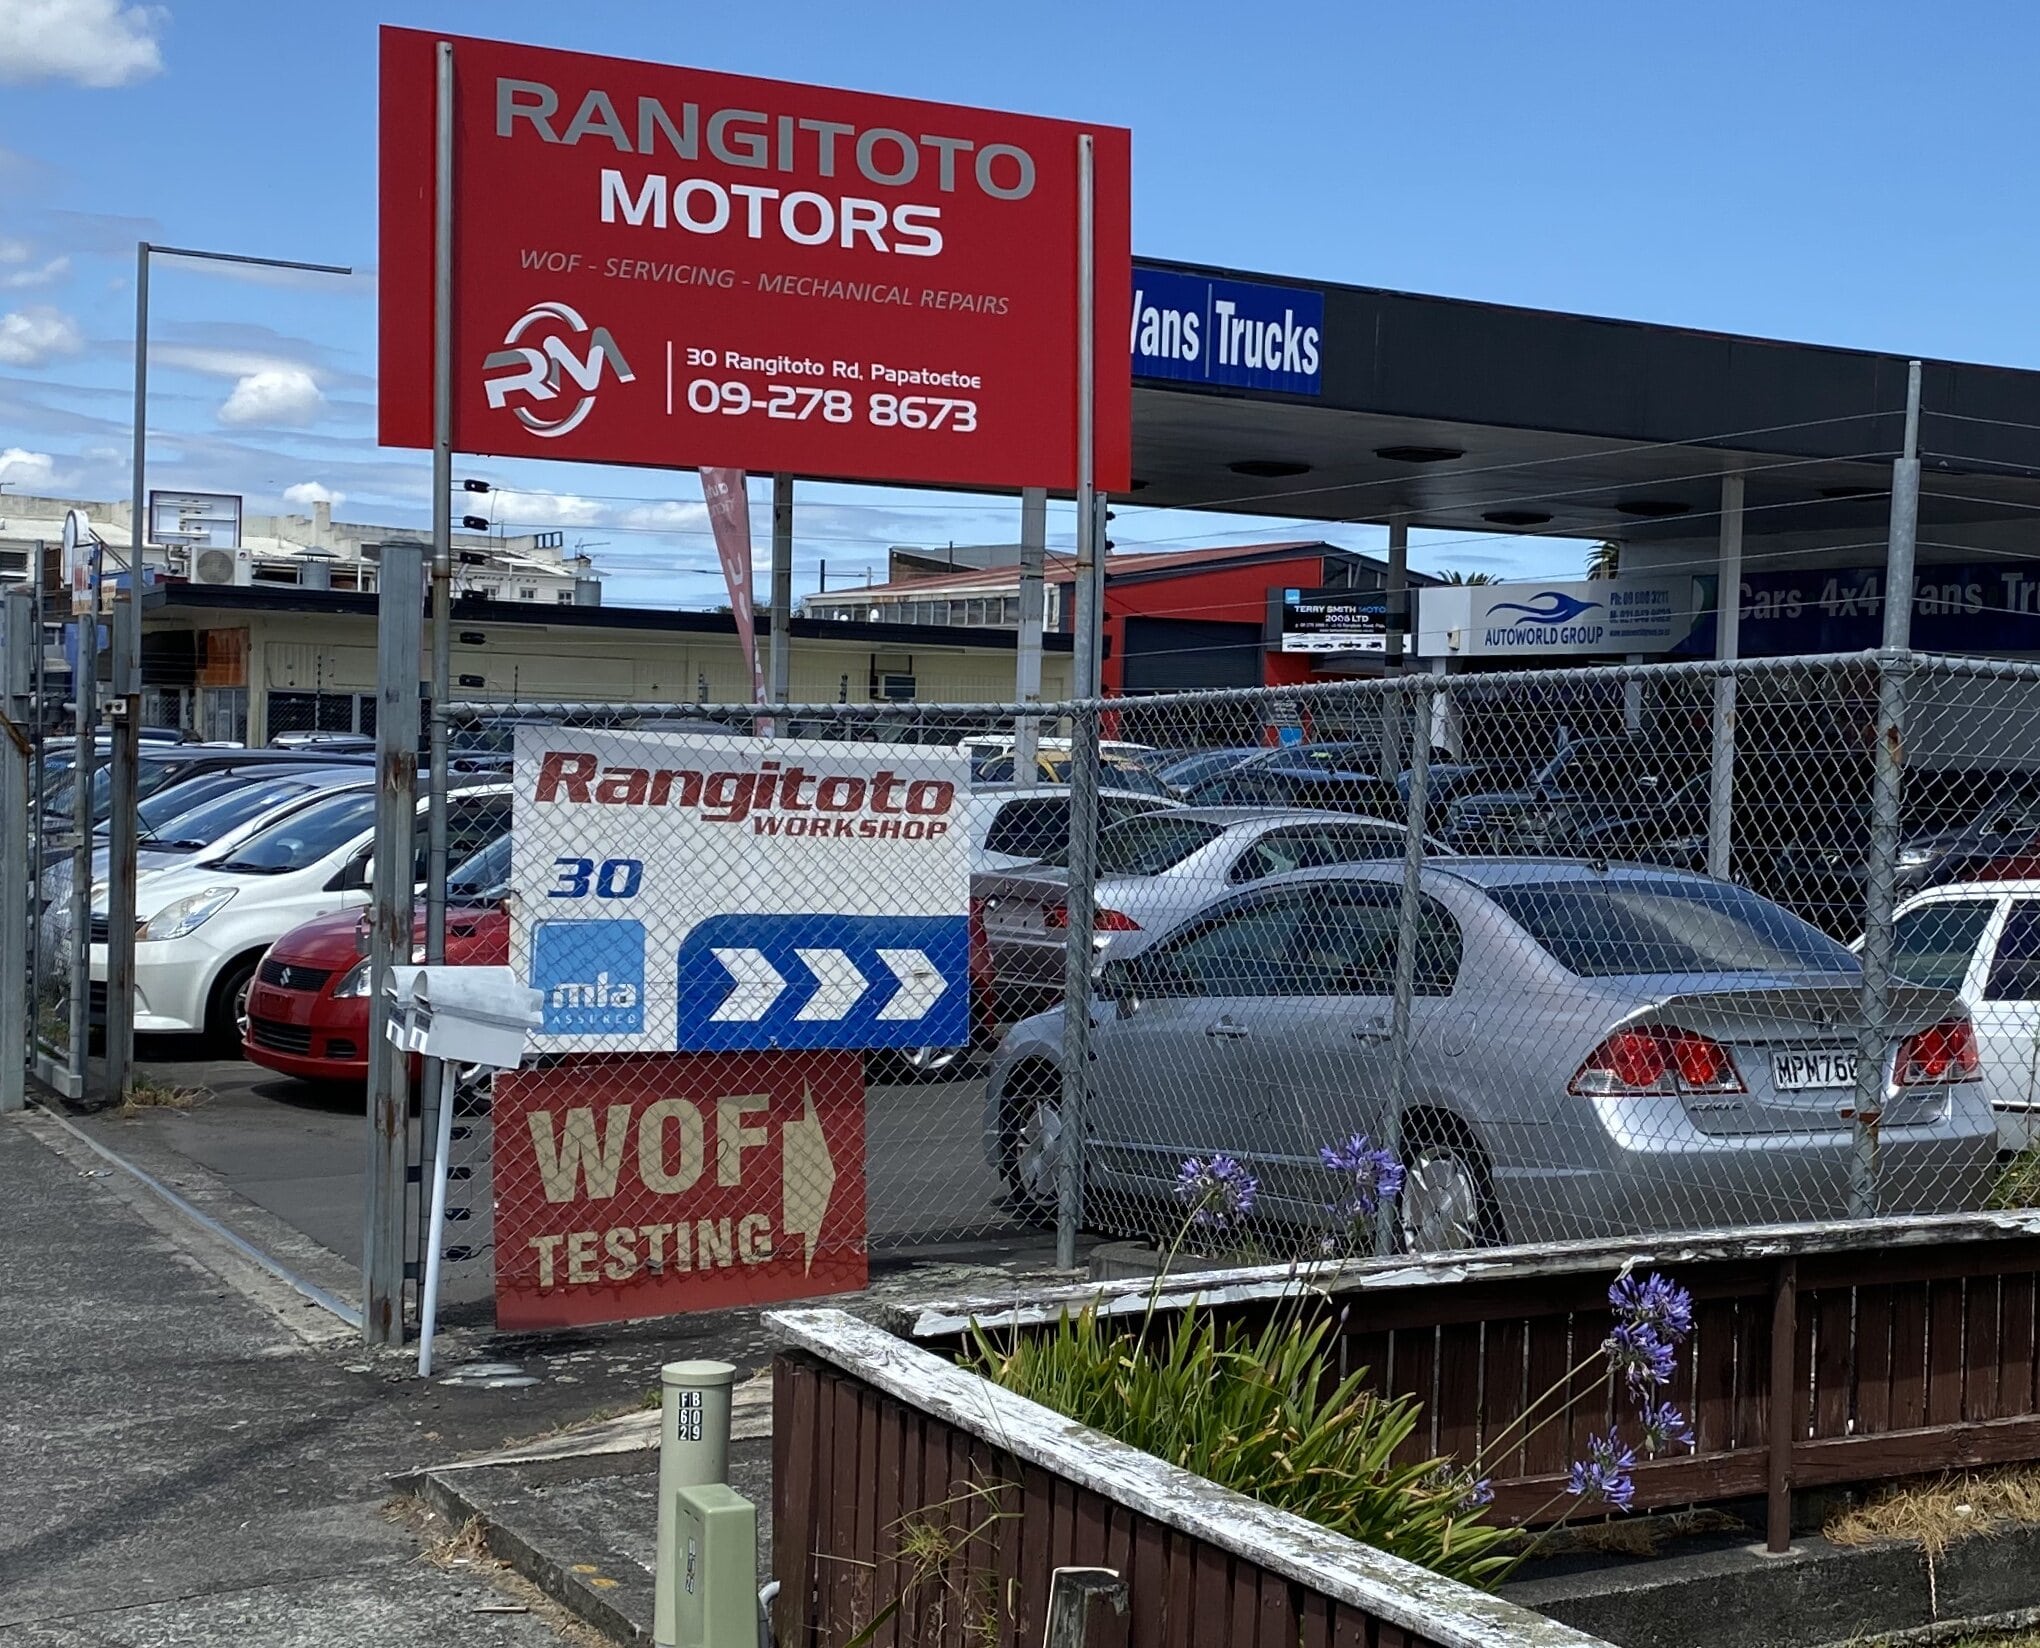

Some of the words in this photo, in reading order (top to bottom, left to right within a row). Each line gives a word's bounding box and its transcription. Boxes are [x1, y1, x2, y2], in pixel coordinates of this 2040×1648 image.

[496, 77, 1036, 200] RANGITOTO
[601, 169, 943, 256] MOTORS
[521, 249, 582, 273] WOF
[603, 257, 736, 288] SERVICING
[758, 273, 912, 306] MECHANICAL
[920, 290, 1009, 314] REPAIRS
[1215, 300, 1319, 375] Trucks
[686, 348, 717, 367] 30
[725, 351, 824, 376] Rangitoto
[871, 363, 981, 389] Papatoetoe
[687, 378, 852, 423] 09-278
[869, 393, 977, 432] 8673
[1294, 605, 1325, 613] TERRY
[1326, 605, 1357, 613] SMITH
[1819, 577, 1880, 617] 4x4
[1908, 576, 1983, 615] ans
[2001, 572, 2040, 613] Tr
[1485, 627, 1558, 646] AUTOWORLD
[1561, 626, 1603, 644] GROUP
[533, 751, 955, 823] Rangitoto
[753, 816, 948, 840] WORKSHOP
[547, 857, 643, 898] 30
[553, 972, 636, 1008] mta
[526, 1093, 770, 1203] WOF
[529, 1214, 774, 1287] TESTING
[680, 1392, 701, 1407] FB
[680, 1409, 701, 1424] 60
[680, 1425, 701, 1440] 29
